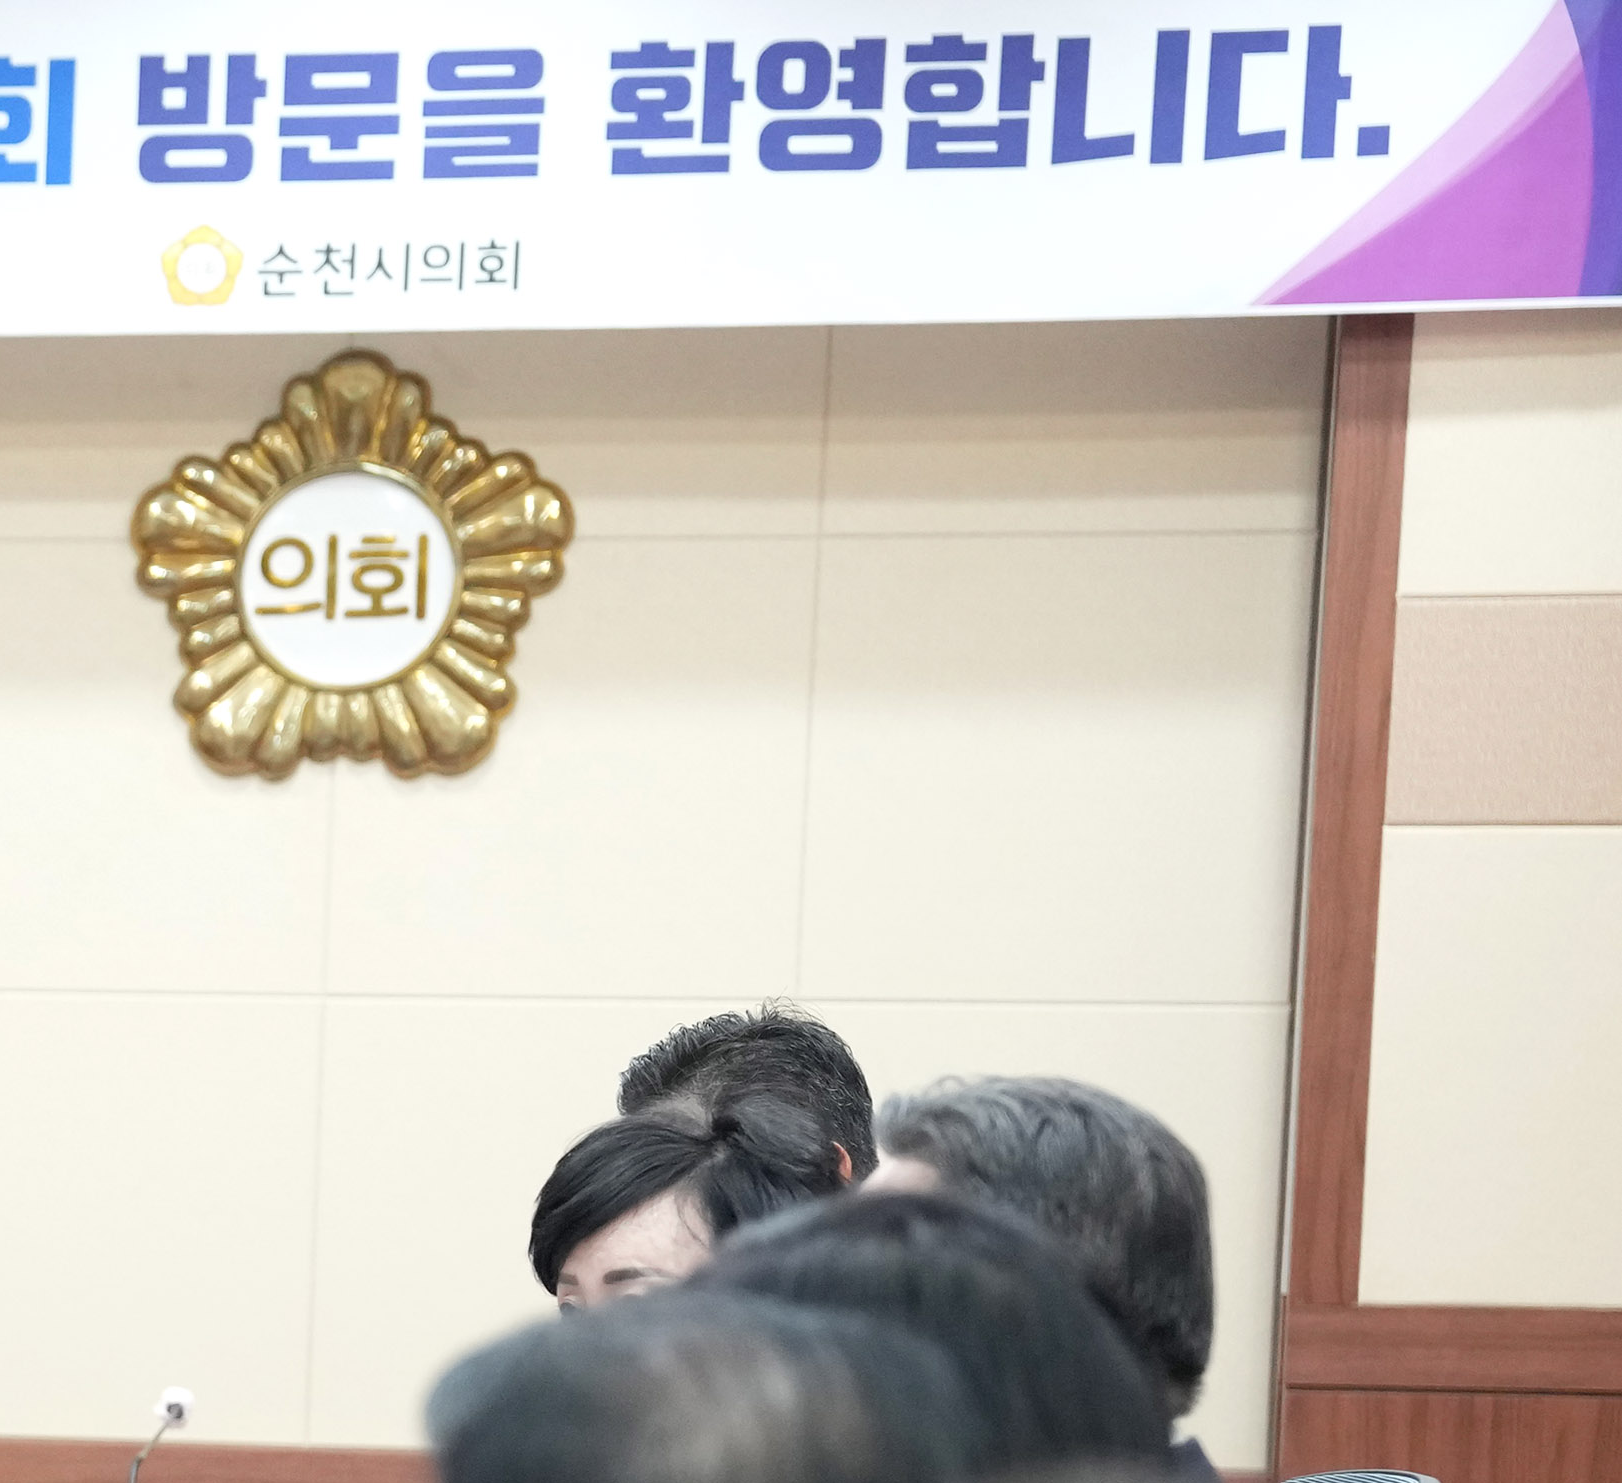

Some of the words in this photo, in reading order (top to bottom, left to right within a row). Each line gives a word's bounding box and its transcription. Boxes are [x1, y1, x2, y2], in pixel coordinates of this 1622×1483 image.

[137, 49, 545, 183] 방문을
[606, 25, 1391, 175] 환영합니다.
[258, 239, 520, 296] 순천시의회
[255, 533, 429, 620] 의회
